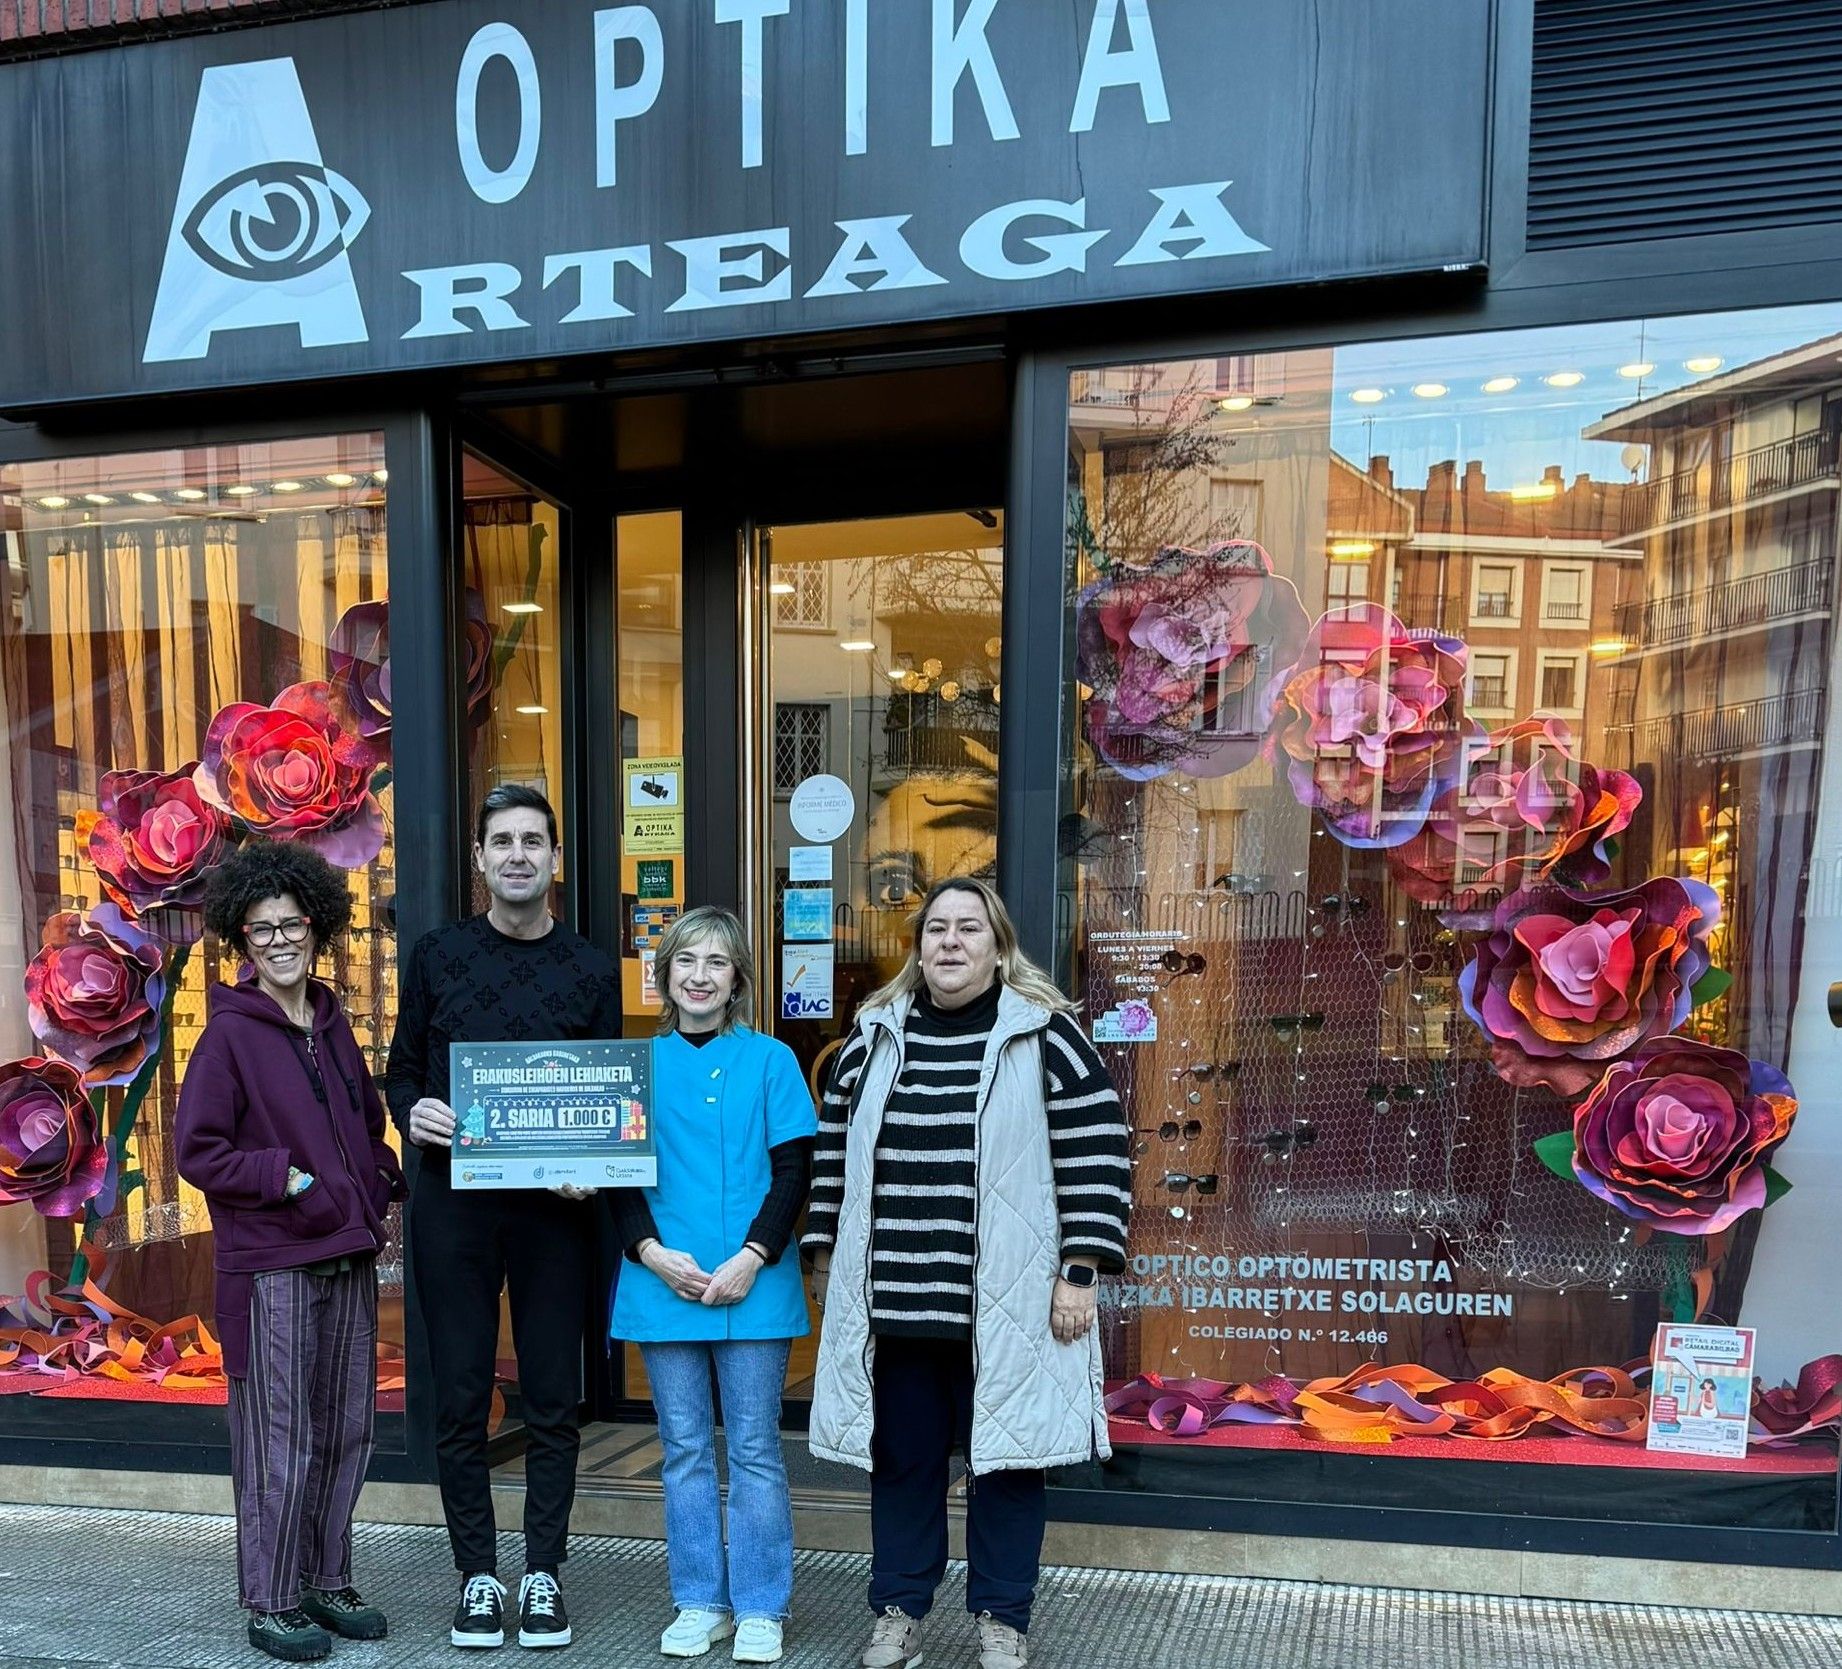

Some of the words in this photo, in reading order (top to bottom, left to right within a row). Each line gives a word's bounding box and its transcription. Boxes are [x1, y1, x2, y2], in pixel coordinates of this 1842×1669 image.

[455, 0, 1171, 203] OPTIKA
[142, 57, 1273, 363] ARTEAGA
[646, 824, 673, 832] OPTIKA
[643, 876, 667, 884] bbk
[1097, 945, 1126, 953] LUNES
[1136, 944, 1175, 952] VIERNES
[472, 1067, 568, 1085] ERAKUSLEIHOEN
[570, 1066, 633, 1083] LEHIAKETA
[490, 1109, 506, 1128] 2.
[508, 1108, 555, 1128] SARIA
[562, 1109, 598, 1126] 1.000
[1132, 1253, 1231, 1278] OPTICO
[1238, 1256, 1453, 1283] OPTOMETRISTA
[1098, 1284, 1174, 1307] AIZKA
[1182, 1286, 1332, 1311] IBARRETXE
[1341, 1290, 1513, 1317] SOLAGUREN
[1188, 1325, 1292, 1341] COLEGIADO
